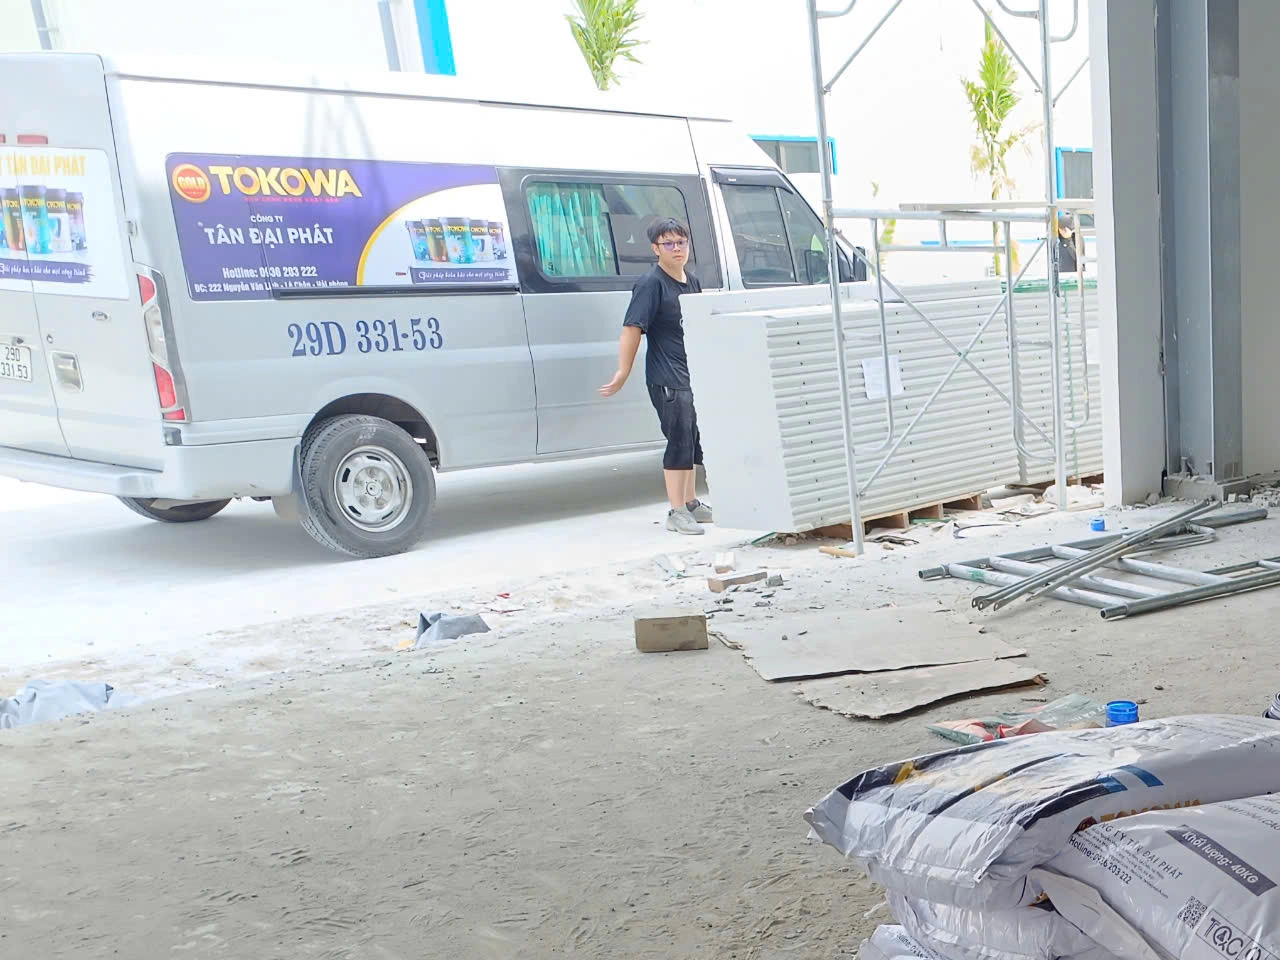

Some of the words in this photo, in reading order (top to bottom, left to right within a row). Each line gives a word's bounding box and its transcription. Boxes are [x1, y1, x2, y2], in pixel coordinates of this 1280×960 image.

[209, 166, 362, 197] TOKOWA
[204, 224, 244, 245] TÂN
[249, 228, 283, 248] ĐẠI
[287, 224, 333, 245] PHÁT
[222, 268, 258, 278] Hotline:
[301, 266, 318, 277] 222
[5, 346, 21, 362] 29D
[288, 322, 346, 358] 29D
[1068, 836, 1094, 858] Hotline:
[1109, 863, 1120, 875] 203
[1120, 872, 1132, 884] 222
[1159, 861, 1183, 880] PHÁT
[1182, 830, 1207, 849] Khối
[1203, 841, 1232, 866] lượng:
[1230, 858, 1259, 884] 40KG
[1203, 917, 1244, 956] TQC
